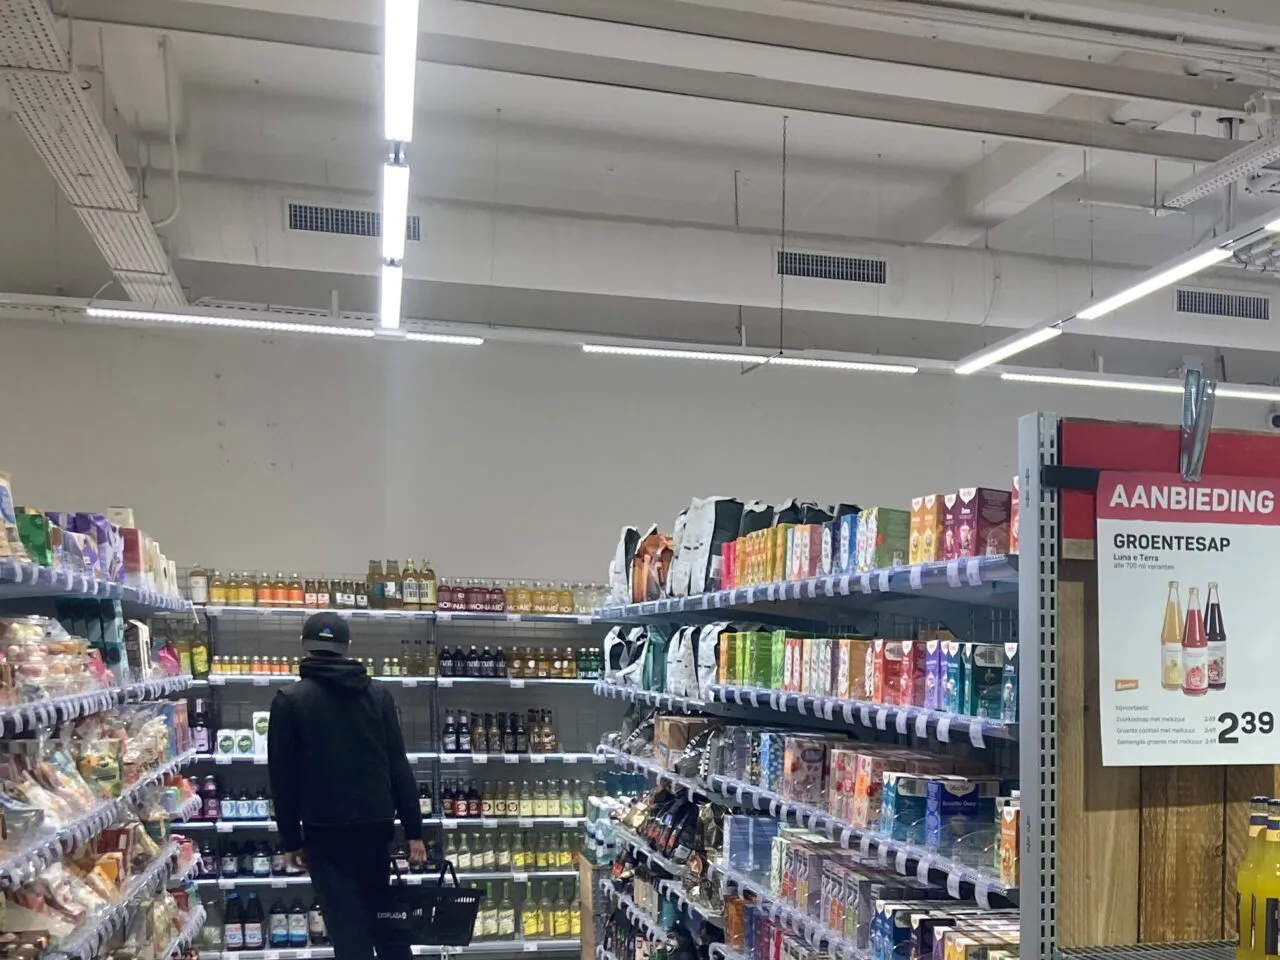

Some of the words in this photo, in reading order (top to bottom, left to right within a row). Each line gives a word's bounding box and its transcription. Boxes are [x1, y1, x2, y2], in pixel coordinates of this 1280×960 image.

[1110, 484, 1274, 513] AANBIEDING
[1114, 534, 1230, 552] GROENTESAP
[1140, 554, 1159, 562] Terra
